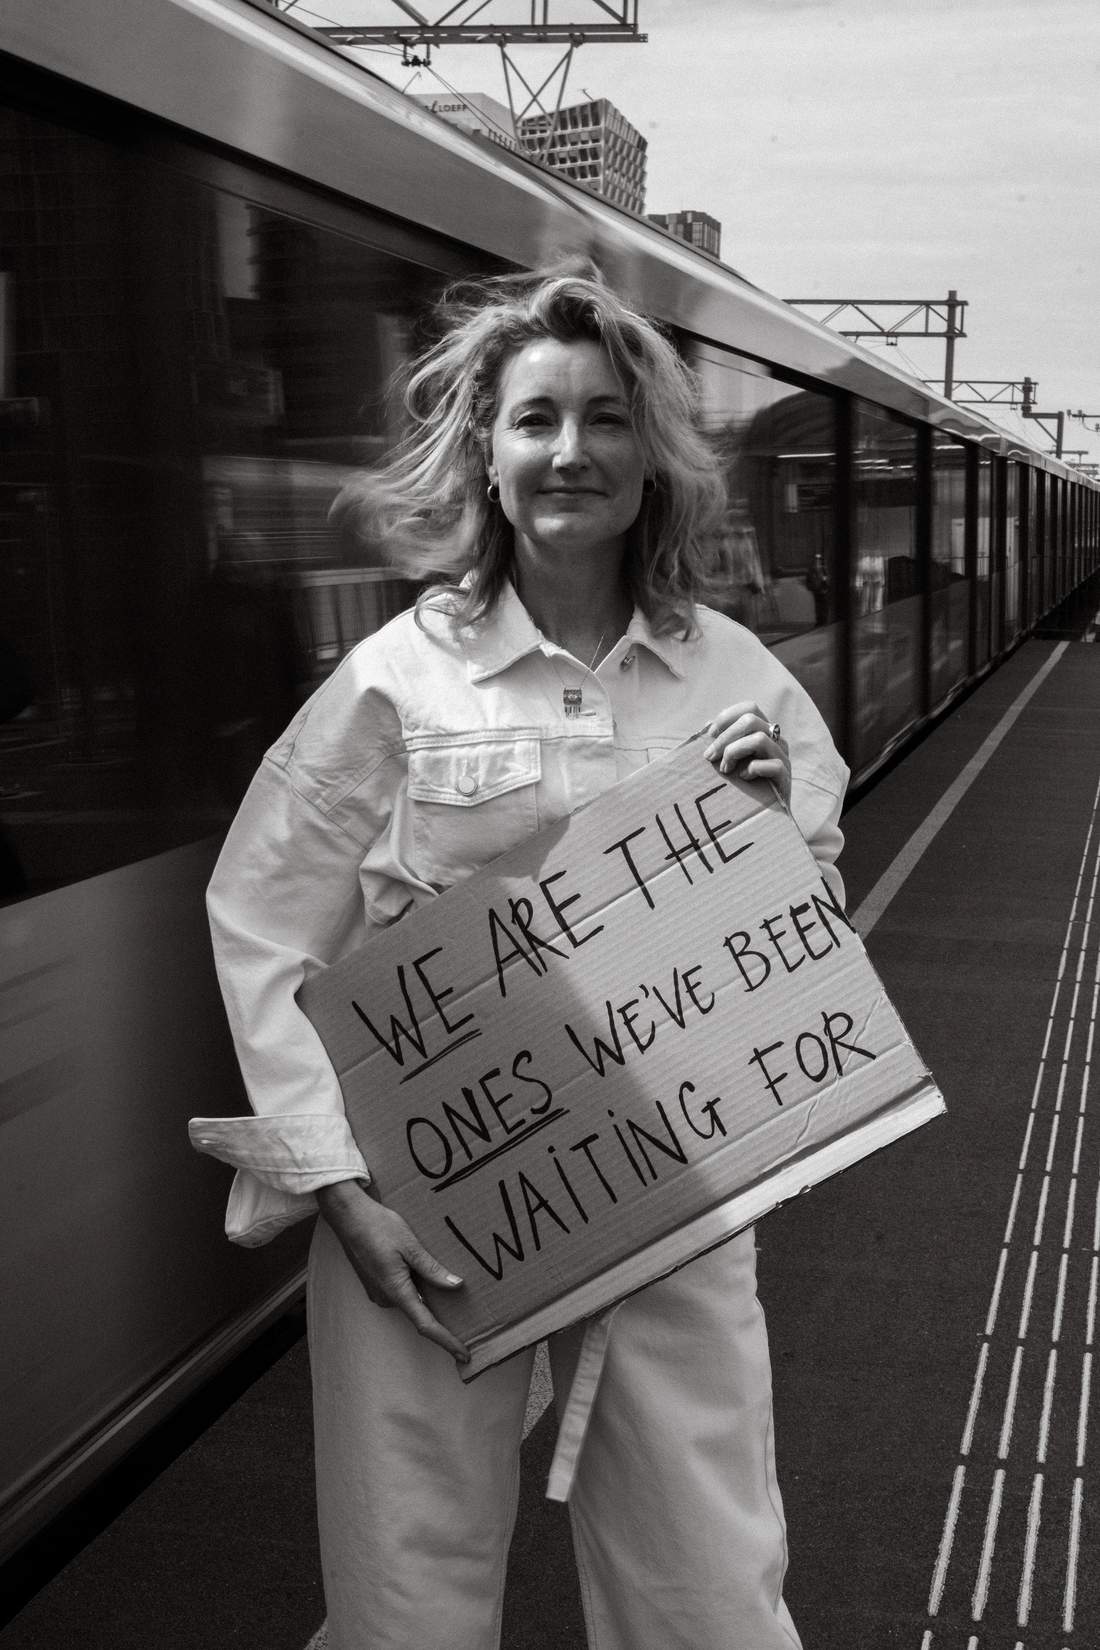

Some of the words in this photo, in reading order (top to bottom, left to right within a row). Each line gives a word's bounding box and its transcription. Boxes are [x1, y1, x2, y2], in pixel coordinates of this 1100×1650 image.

[352, 947, 475, 1067] WE
[487, 869, 604, 998] ARE
[603, 783, 755, 910] THE
[405, 1049, 554, 1180] ONES
[564, 964, 715, 1078] WE'VE
[723, 876, 857, 993] BEEN
[748, 1011, 876, 1106] FOR
